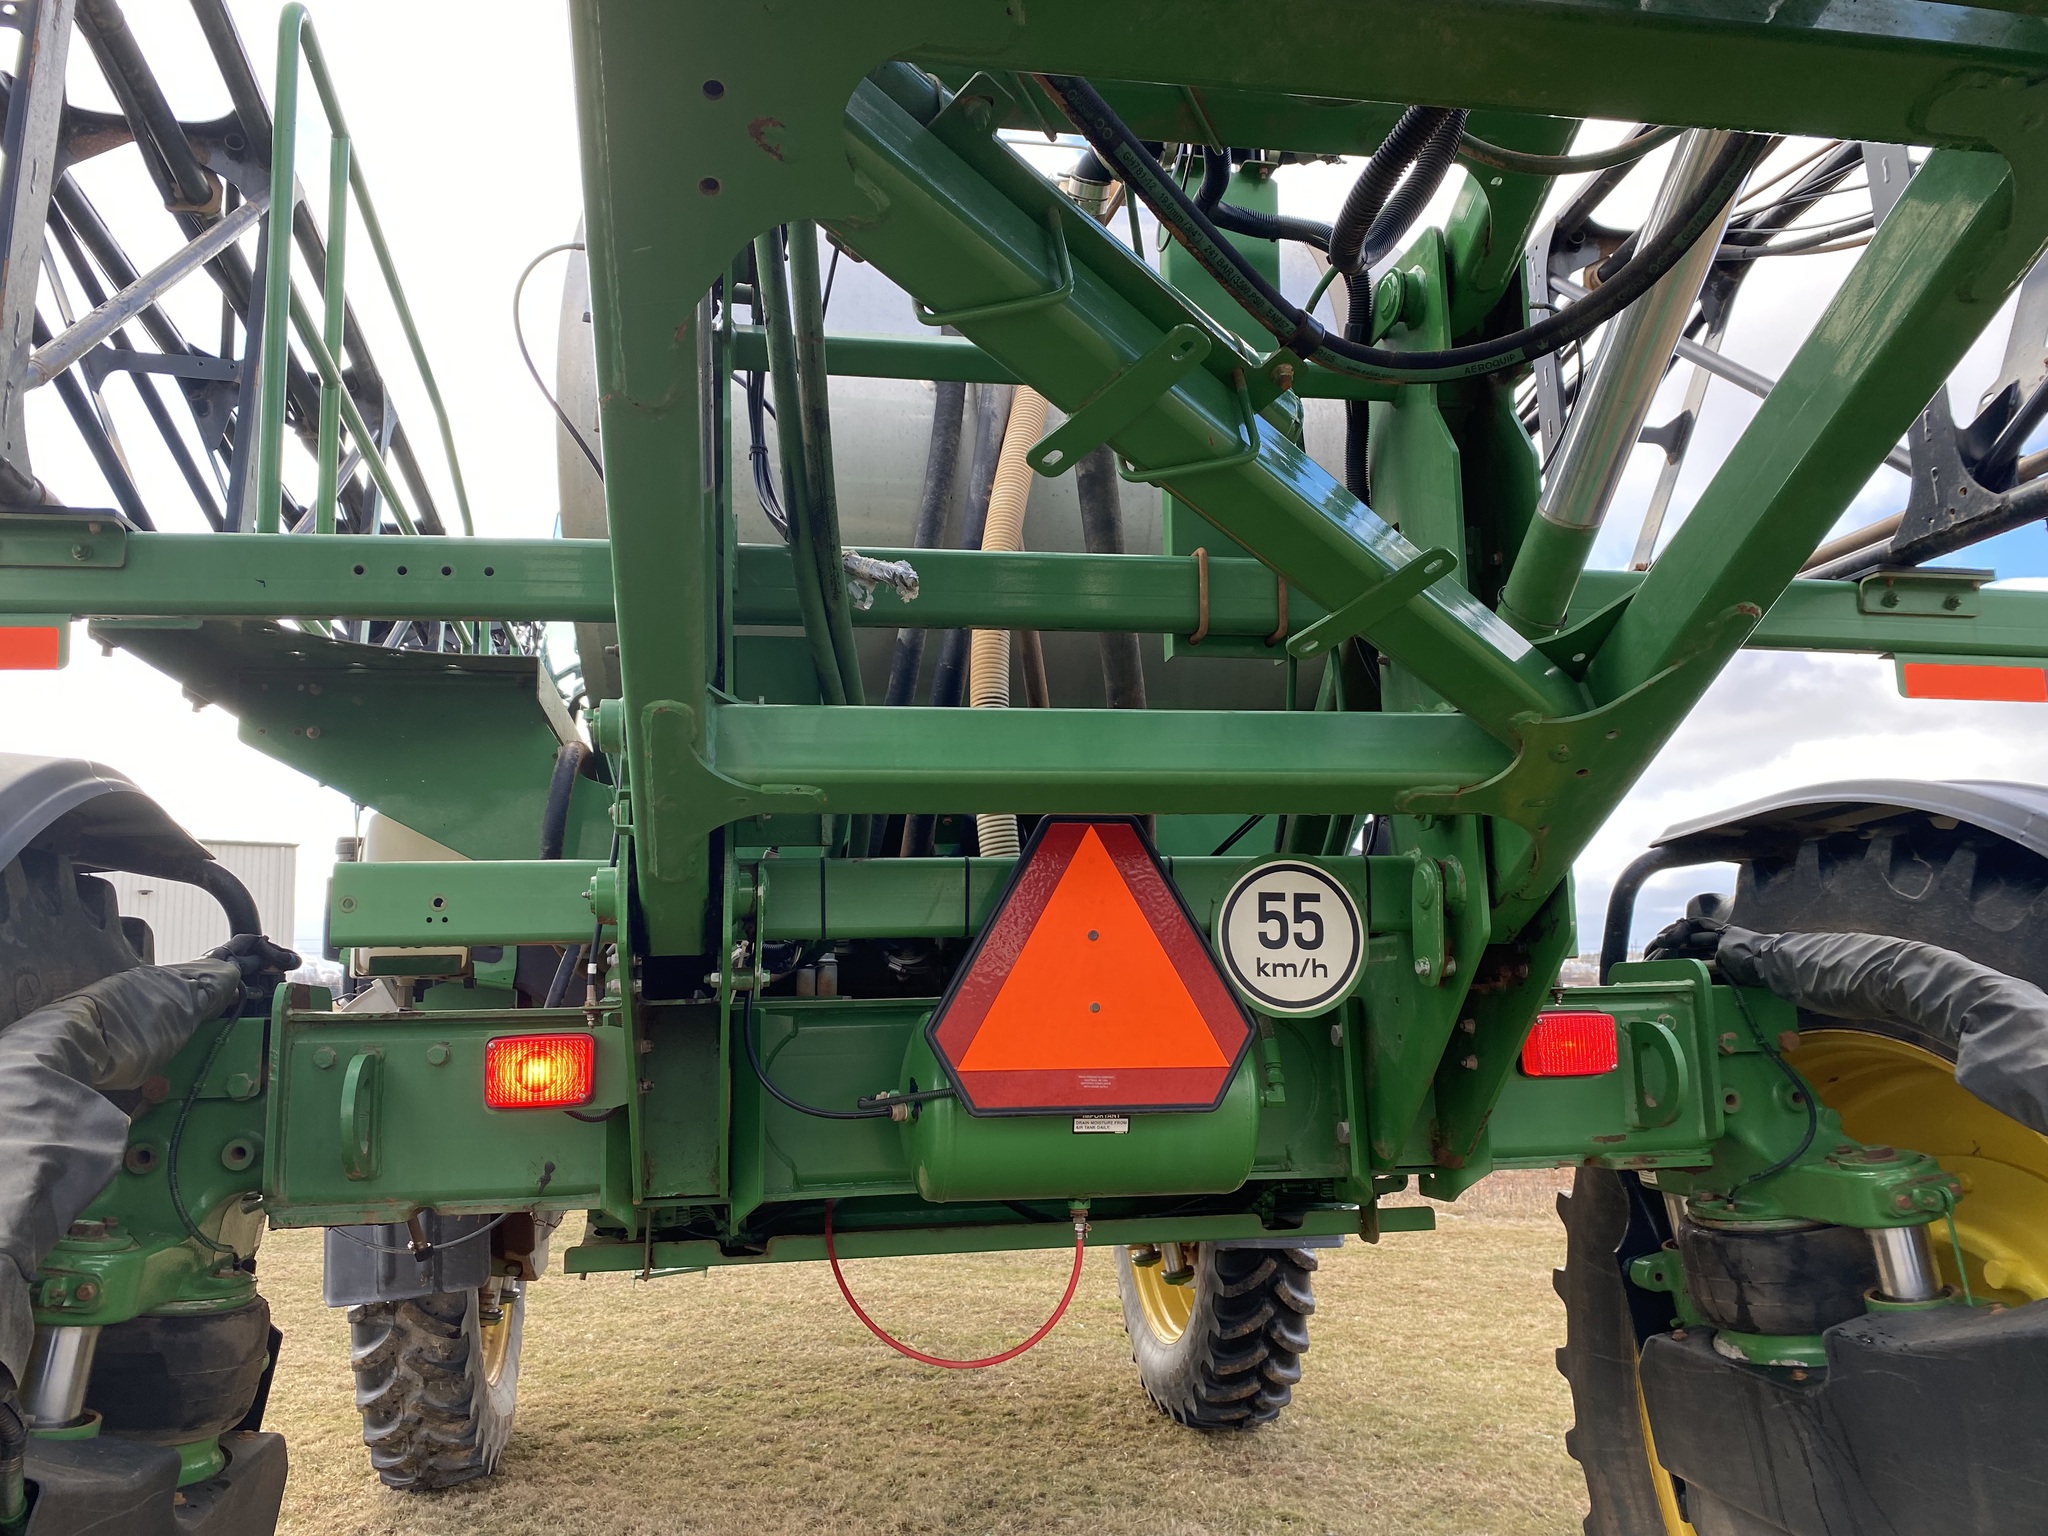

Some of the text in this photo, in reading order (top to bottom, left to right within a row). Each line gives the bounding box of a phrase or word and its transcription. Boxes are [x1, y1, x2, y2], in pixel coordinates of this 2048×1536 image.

[1123, 151, 1157, 191] GH781-12
[1159, 192, 1184, 226] 19.0mm
[1204, 244, 1219, 259] 241
[1217, 258, 1235, 277] BAR
[1230, 273, 1251, 295] (3500
[1248, 289, 1265, 309] PSI)
[1266, 308, 1291, 329] EN857
[1464, 353, 1517, 375] AEROQUIP
[1257, 891, 1325, 951] 55
[1256, 957, 1329, 979] km/h
